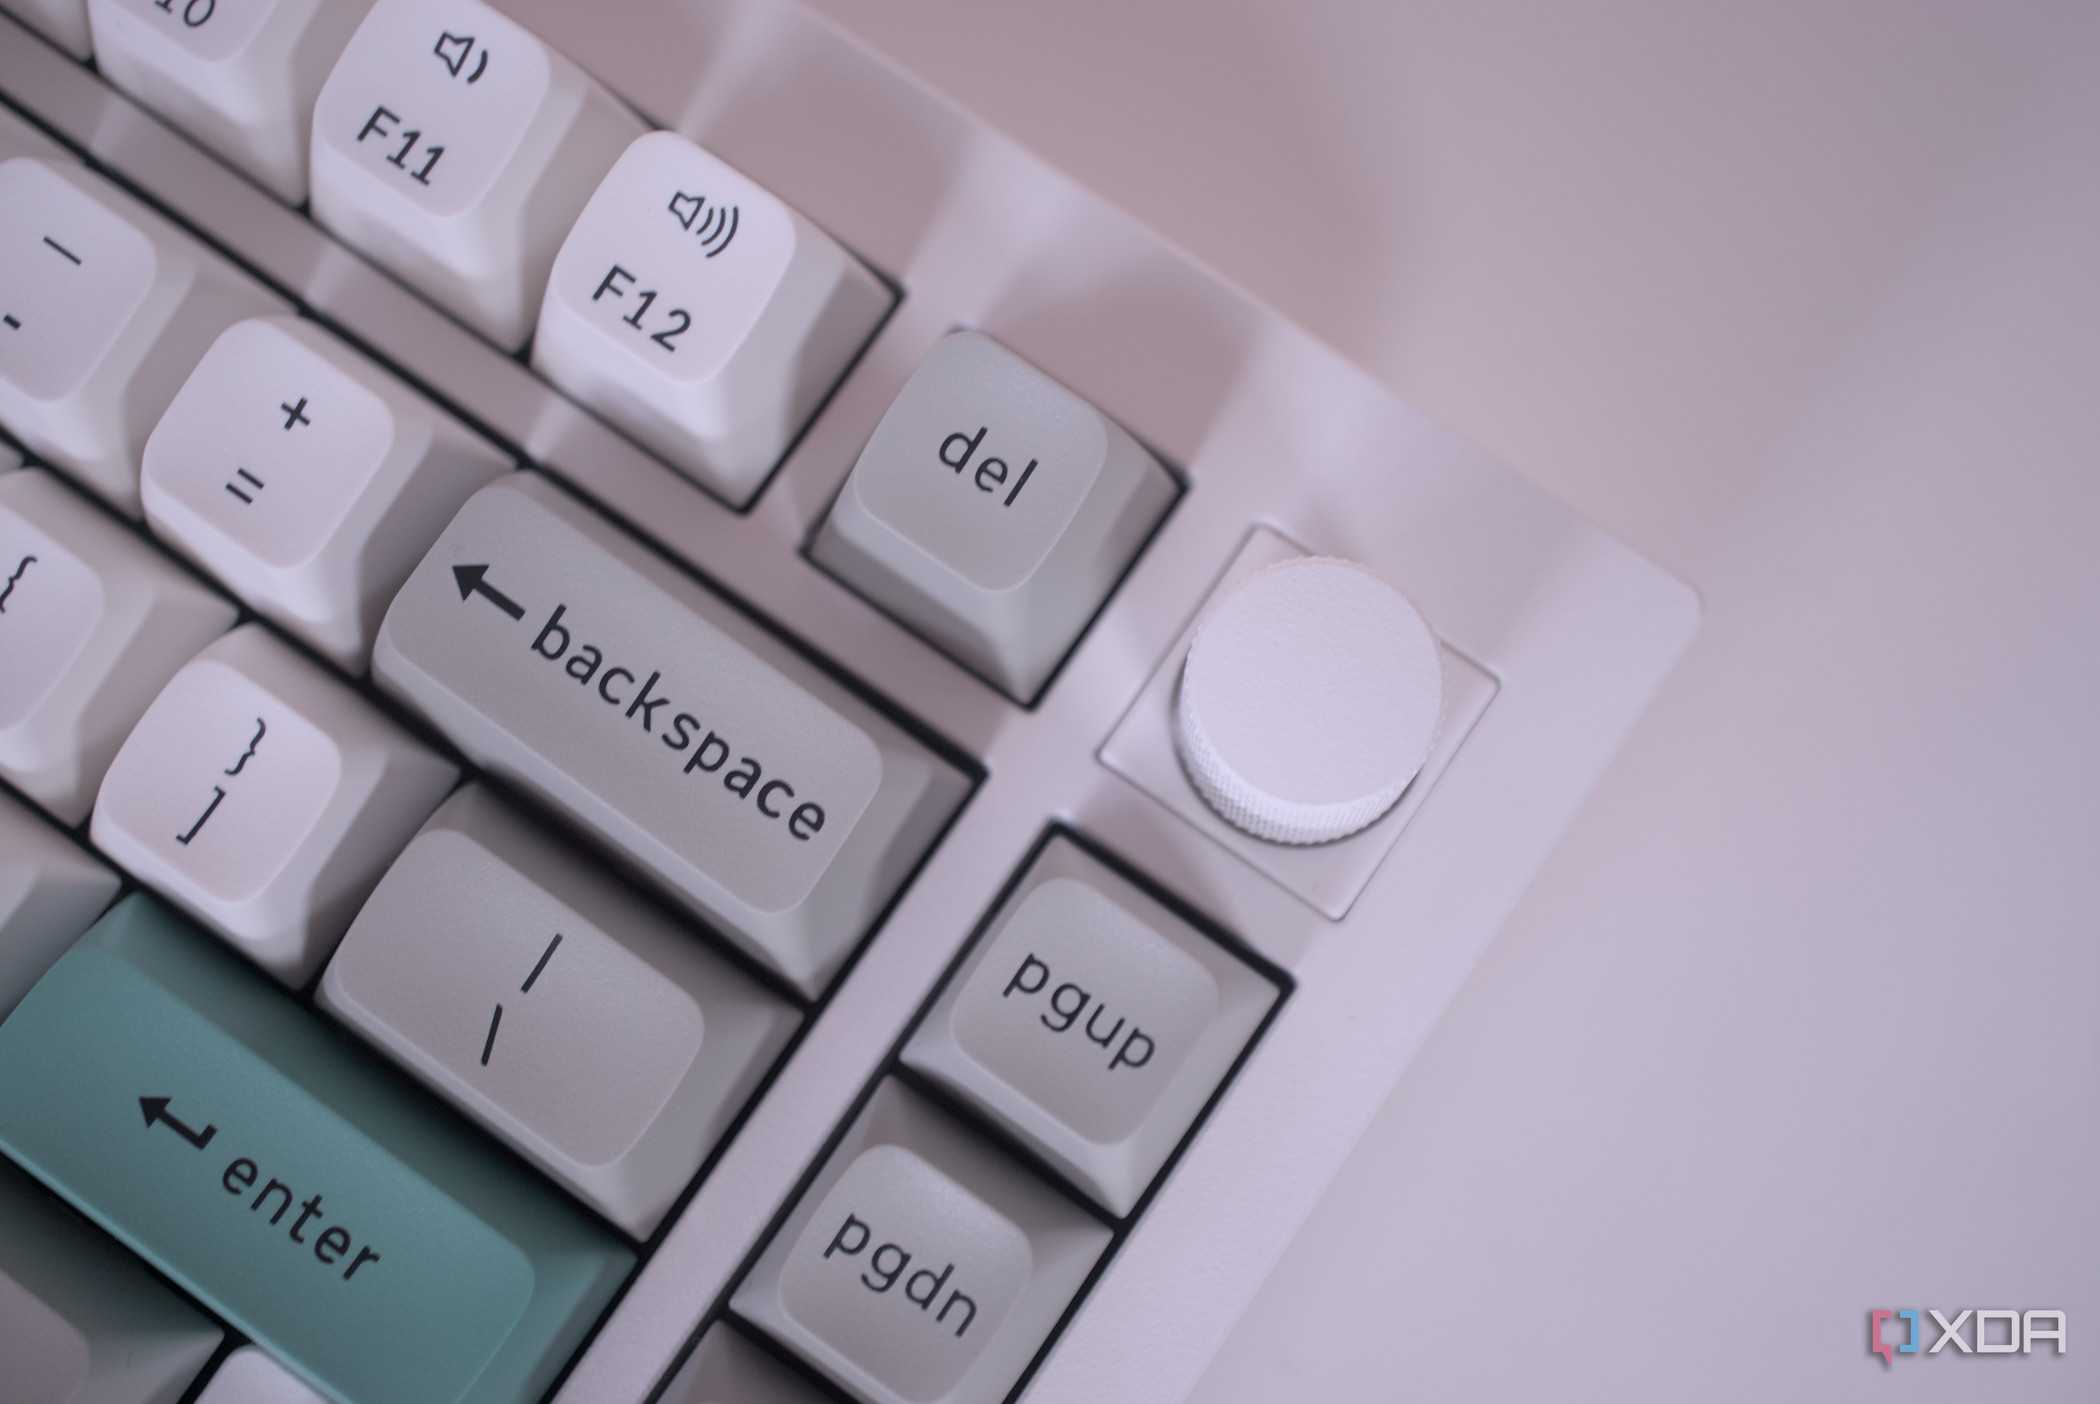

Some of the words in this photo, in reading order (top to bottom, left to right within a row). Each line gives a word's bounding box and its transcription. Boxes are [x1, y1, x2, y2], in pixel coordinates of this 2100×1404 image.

[356, 105, 446, 187] F11
[591, 264, 692, 353] F12
[938, 426, 1039, 508] del
[530, 603, 826, 841] backspace
[1002, 952, 1155, 1070] pgup
[222, 1158, 380, 1281] enter
[823, 1213, 977, 1337] pgdn
